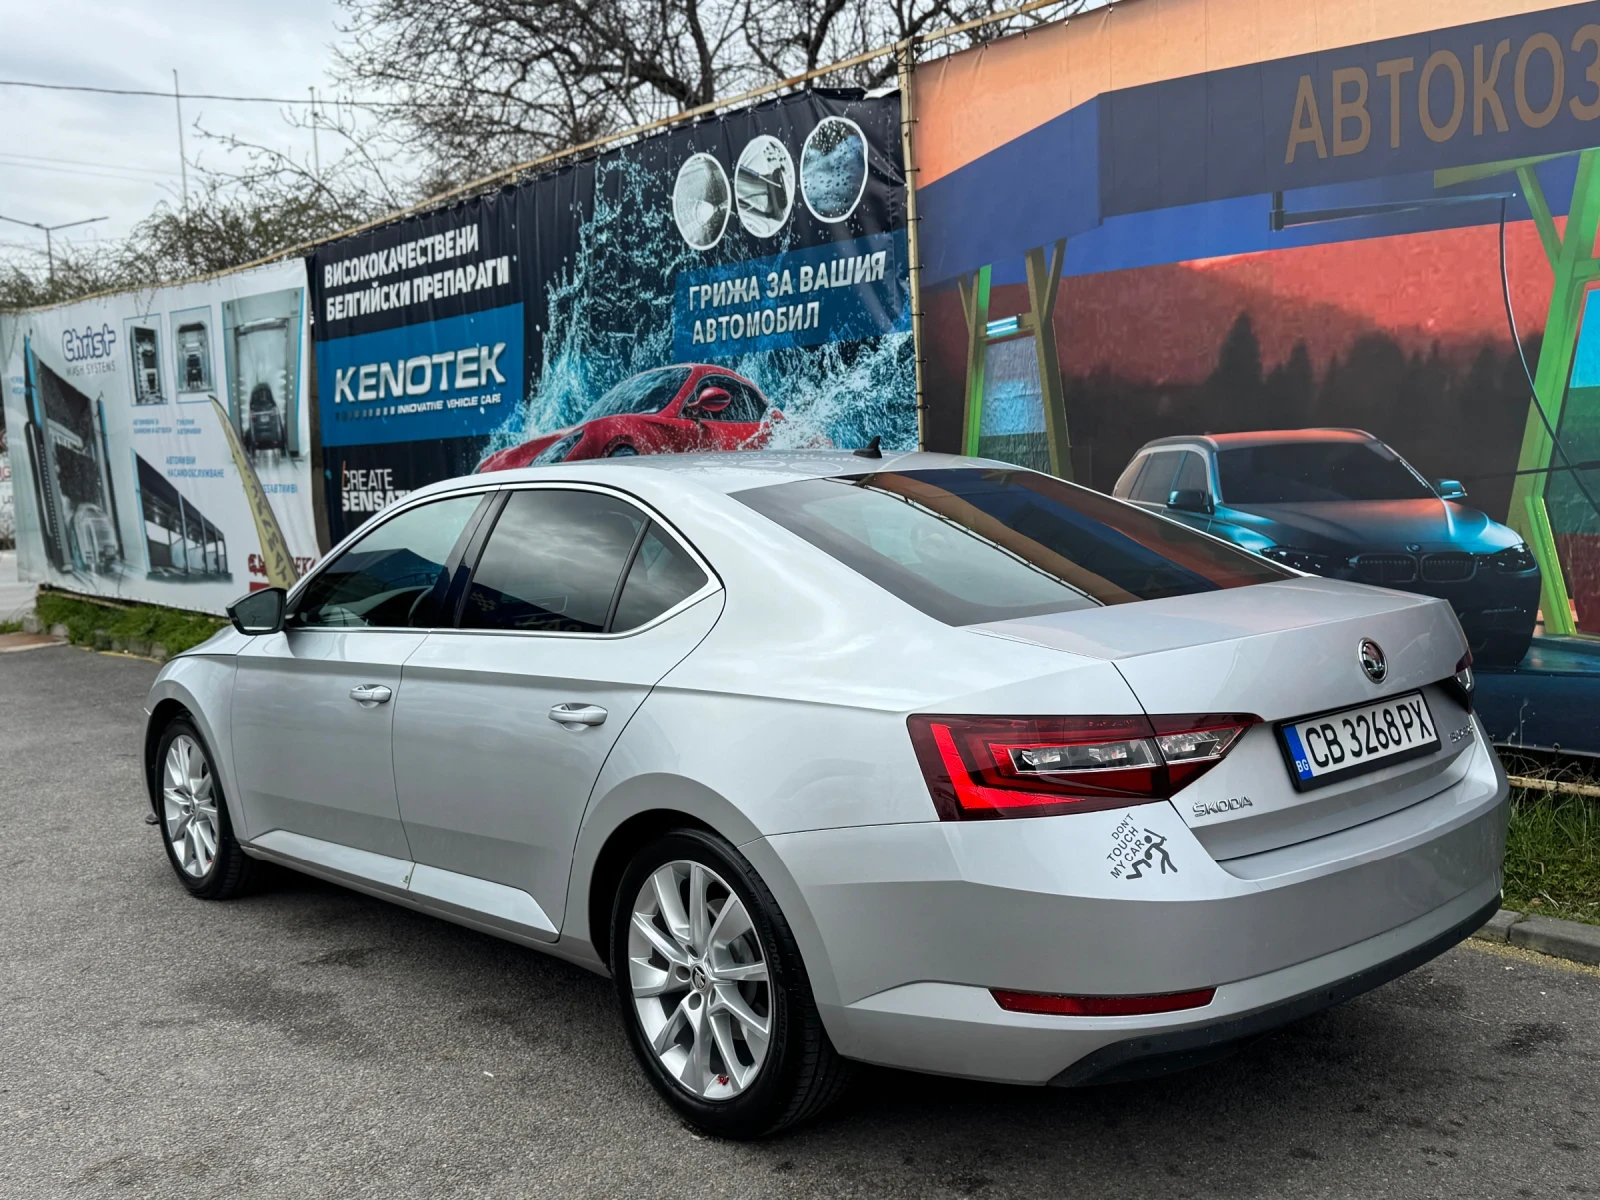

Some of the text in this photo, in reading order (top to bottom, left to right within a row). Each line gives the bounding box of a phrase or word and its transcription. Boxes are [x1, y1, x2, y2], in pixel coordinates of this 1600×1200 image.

[324, 224, 479, 288] ВИСОКОКАЧЕСТВЕНИ
[689, 250, 887, 311] ГРИЖА ЗА ВАШИЯ
[326, 283, 411, 322] БЕЛГИЙСКИ
[62, 322, 116, 362] Christ
[692, 301, 819, 345] АВТОМОБИЛ
[335, 342, 507, 404] KENOTEK
[397, 393, 502, 414] INNOVATIVE VEHICLE CARE
[342, 468, 394, 491] CREATE
[342, 489, 412, 512] SENSAT
[1305, 723, 1345, 768] CB
[1342, 708, 1401, 758] 3268
[1396, 700, 1433, 743] PX
[1296, 760, 1310, 773] BG
[1192, 795, 1254, 818] ŠKODA
[1106, 826, 1139, 862] TOUCH
[1111, 812, 1134, 841] DON'T
[1110, 838, 1146, 879] MY CAR
